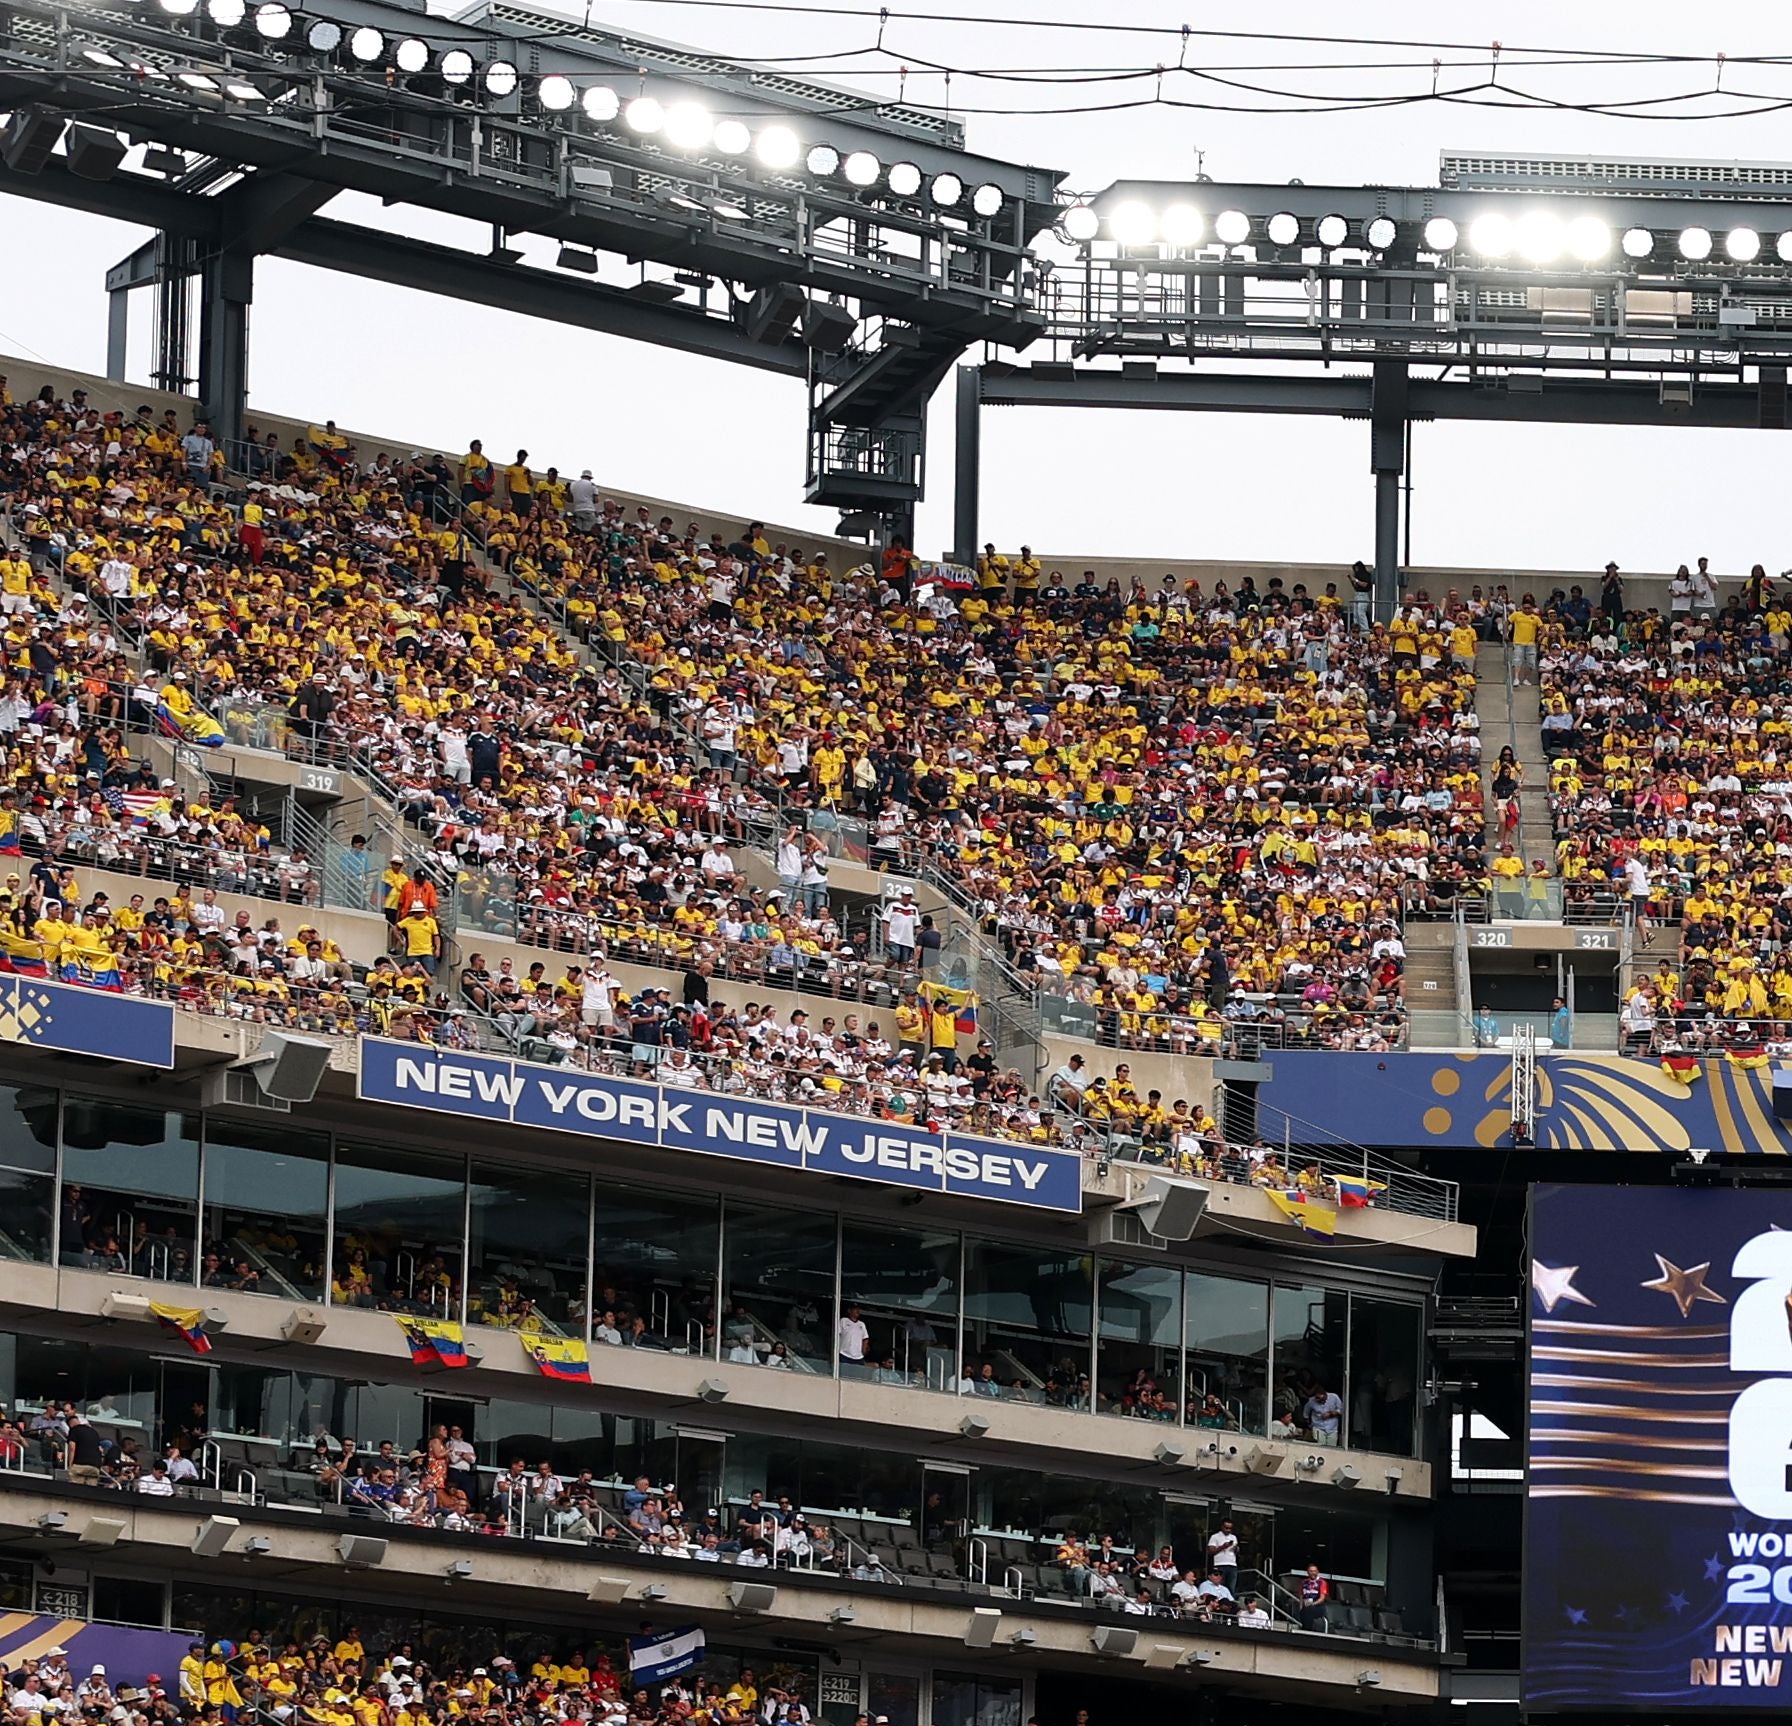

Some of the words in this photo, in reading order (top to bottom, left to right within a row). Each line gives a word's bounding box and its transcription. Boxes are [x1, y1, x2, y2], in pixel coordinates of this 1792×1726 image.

[307, 774, 333, 791] 319
[1477, 933, 1507, 946] 320
[1582, 935, 1609, 948] 321
[395, 1057, 526, 1105] NEW
[540, 1081, 693, 1134] YORK
[706, 1107, 829, 1156] NEW
[841, 1132, 1048, 1190] JERSEY
[1690, 1658, 1782, 1687] NEW
